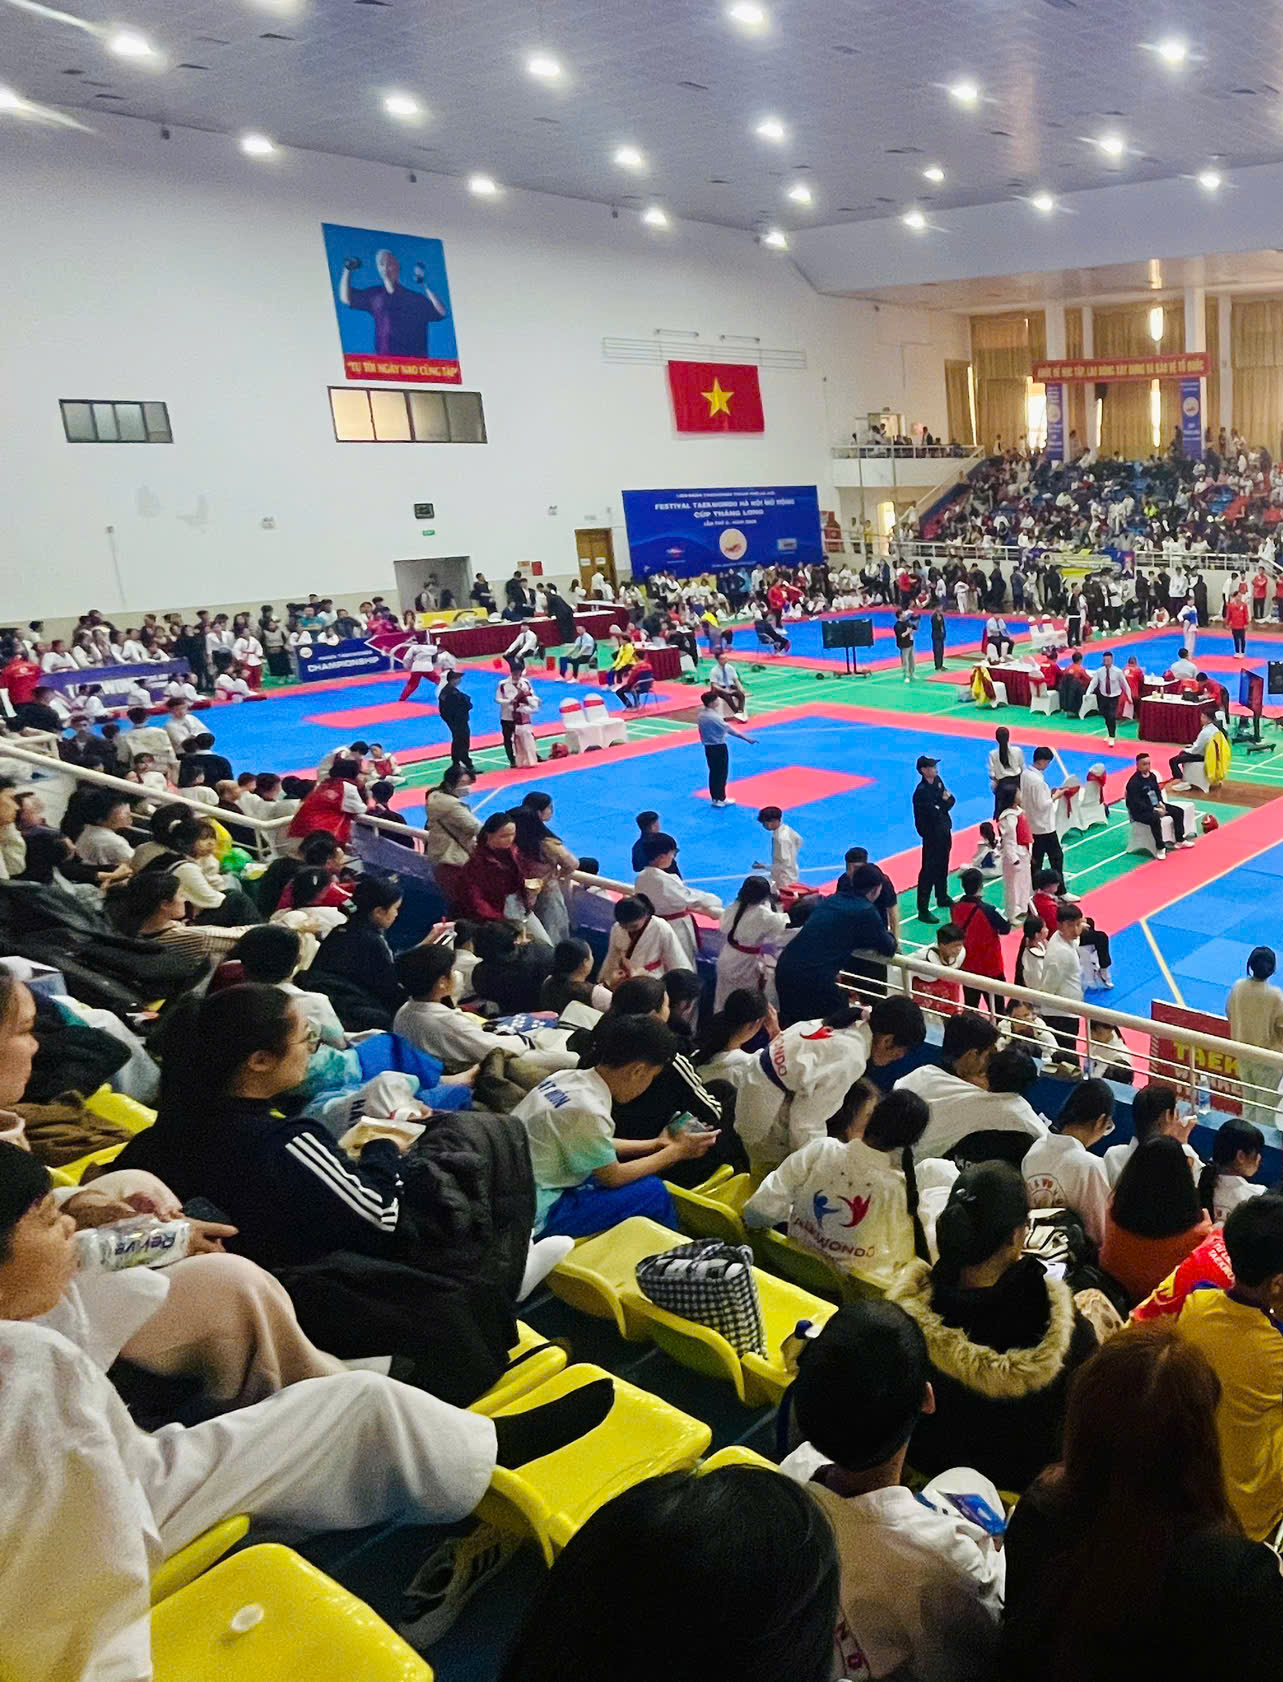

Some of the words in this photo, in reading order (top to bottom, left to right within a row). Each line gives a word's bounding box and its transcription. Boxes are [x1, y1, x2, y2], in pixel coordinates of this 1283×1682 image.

[654, 502, 691, 510] FESTIVAL
[693, 500, 738, 509] TAEKWONDO
[743, 508, 764, 516] LONG
[307, 655, 380, 673] CHAMPIONSHIP
